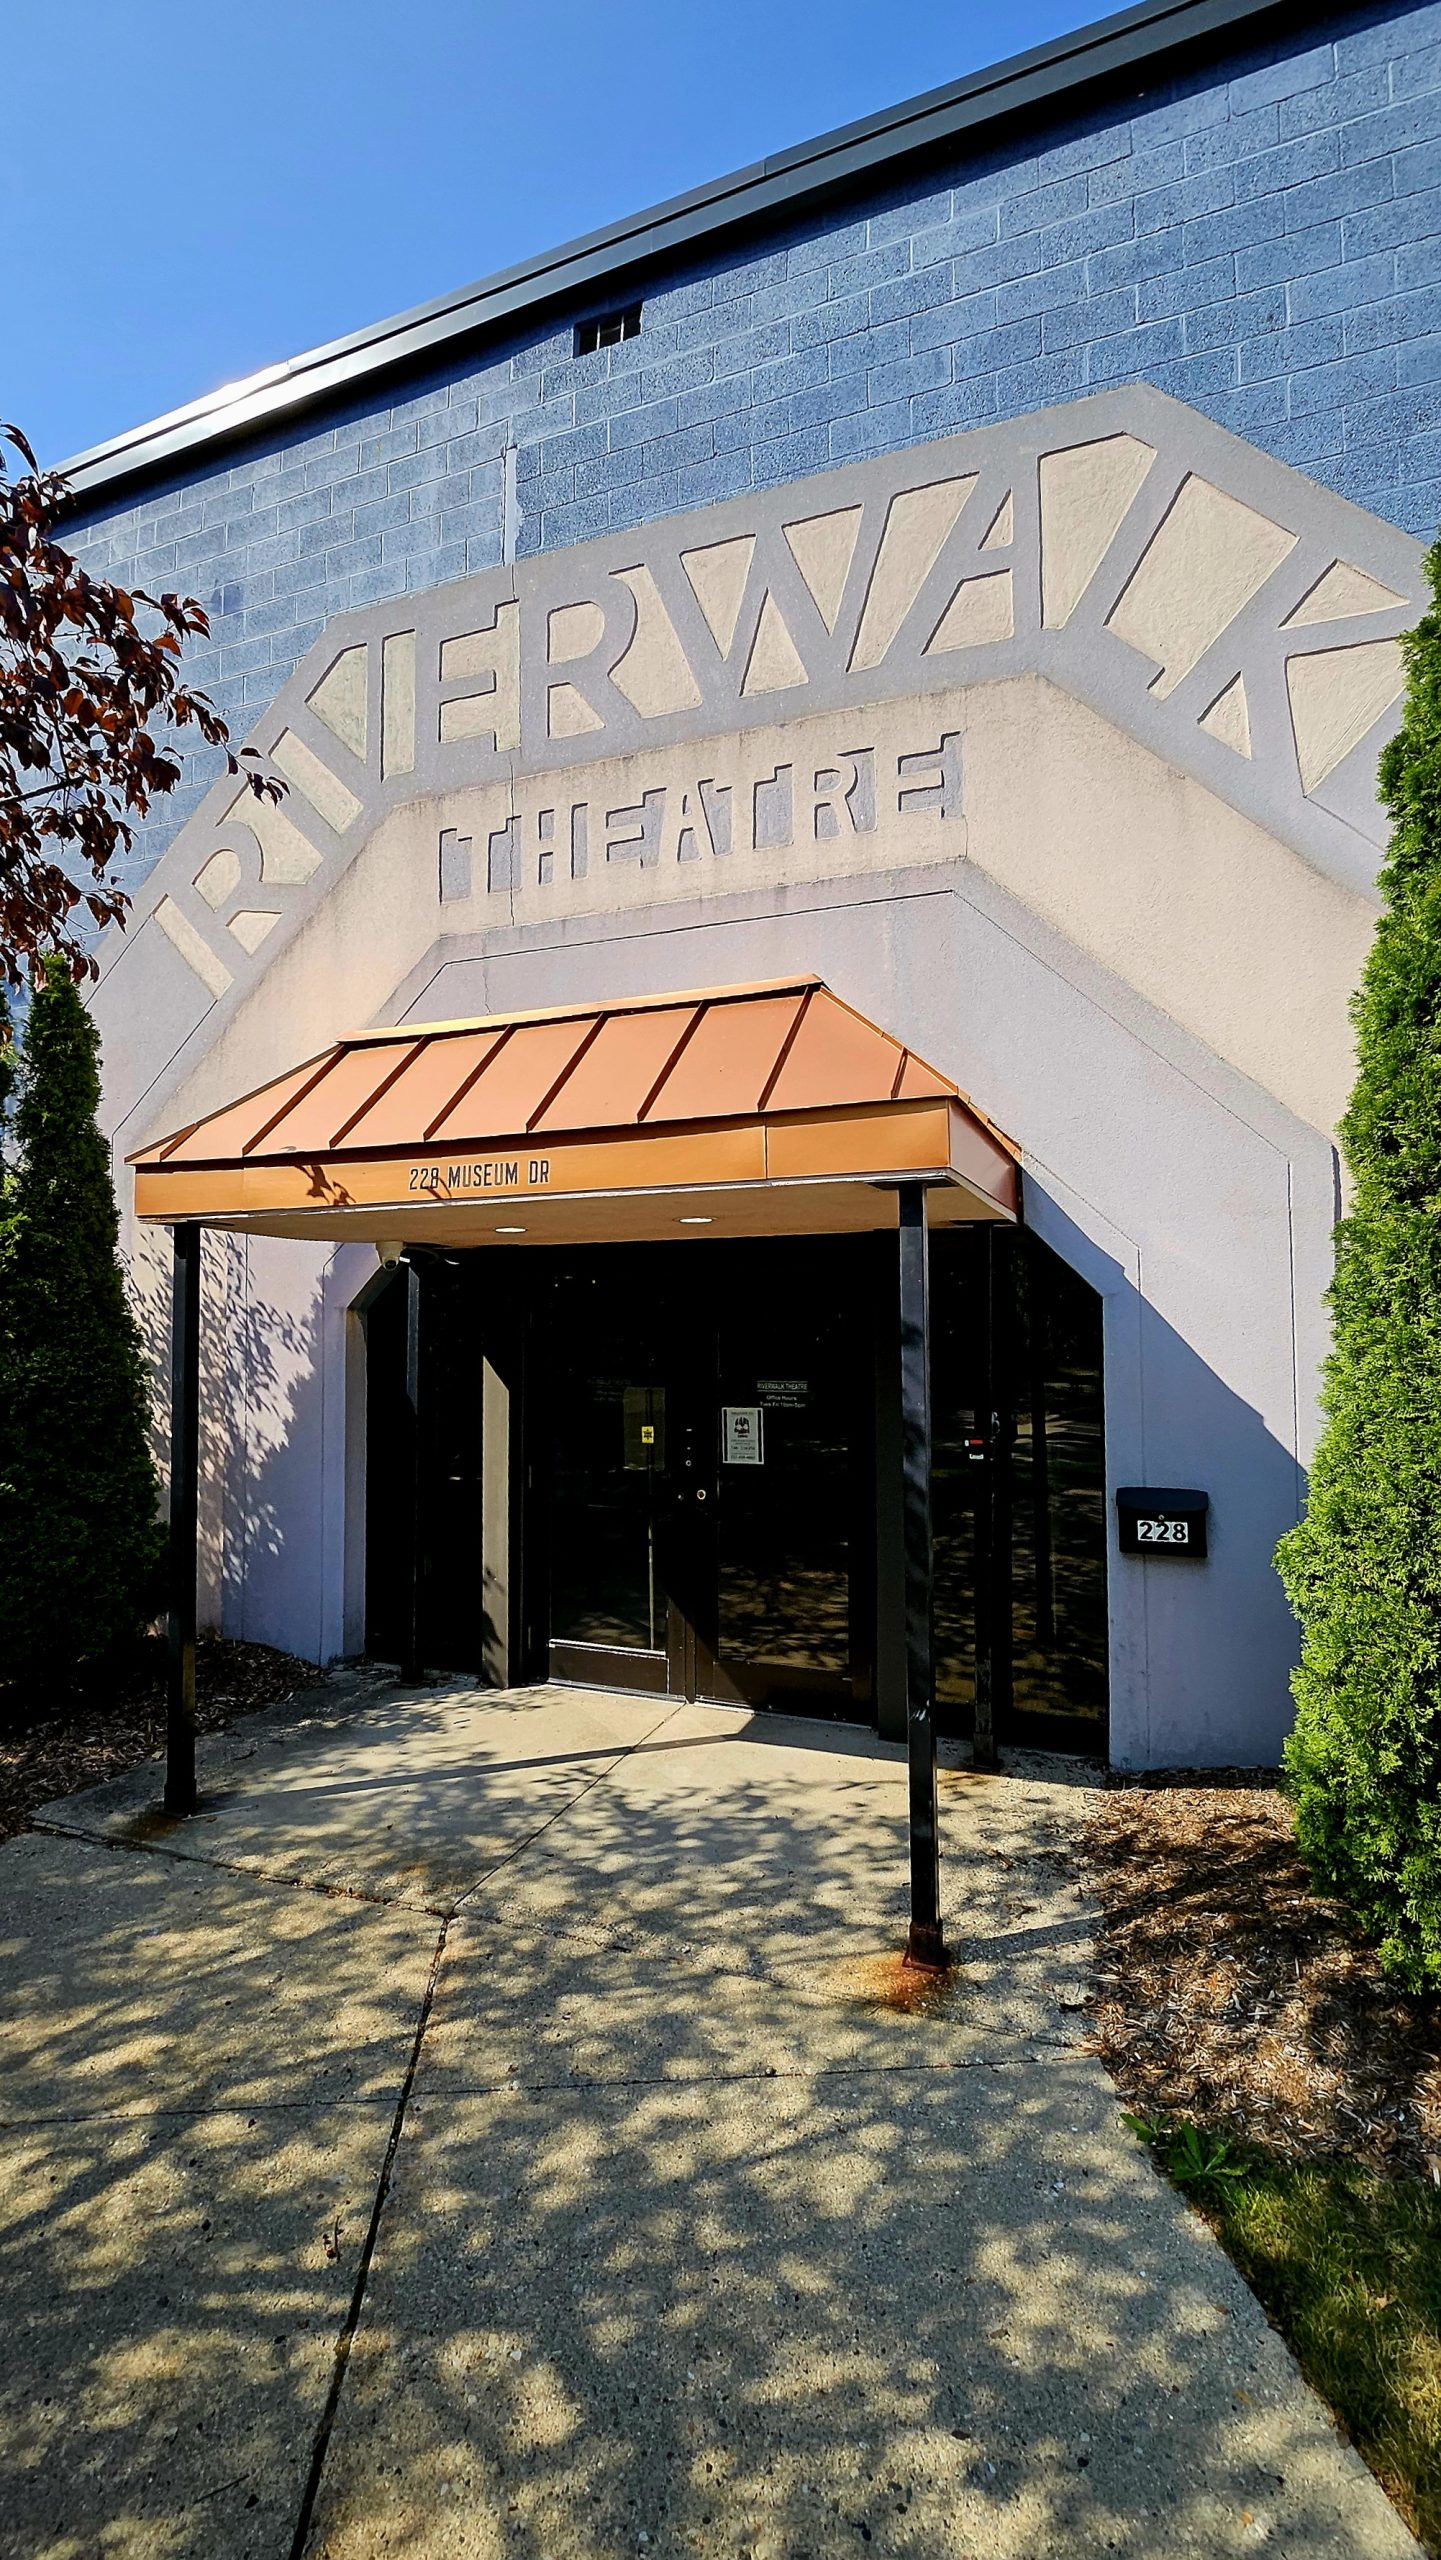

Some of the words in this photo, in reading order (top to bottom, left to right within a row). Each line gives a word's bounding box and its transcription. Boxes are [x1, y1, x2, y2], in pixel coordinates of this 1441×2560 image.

[155, 445, 1412, 998] RIVERWALK
[442, 730, 963, 903] THEATRE
[409, 1167, 439, 1190] 228
[447, 1162, 518, 1188] MUSEUM
[529, 1160, 549, 1184] DR
[1138, 1521, 1187, 1542] 228
